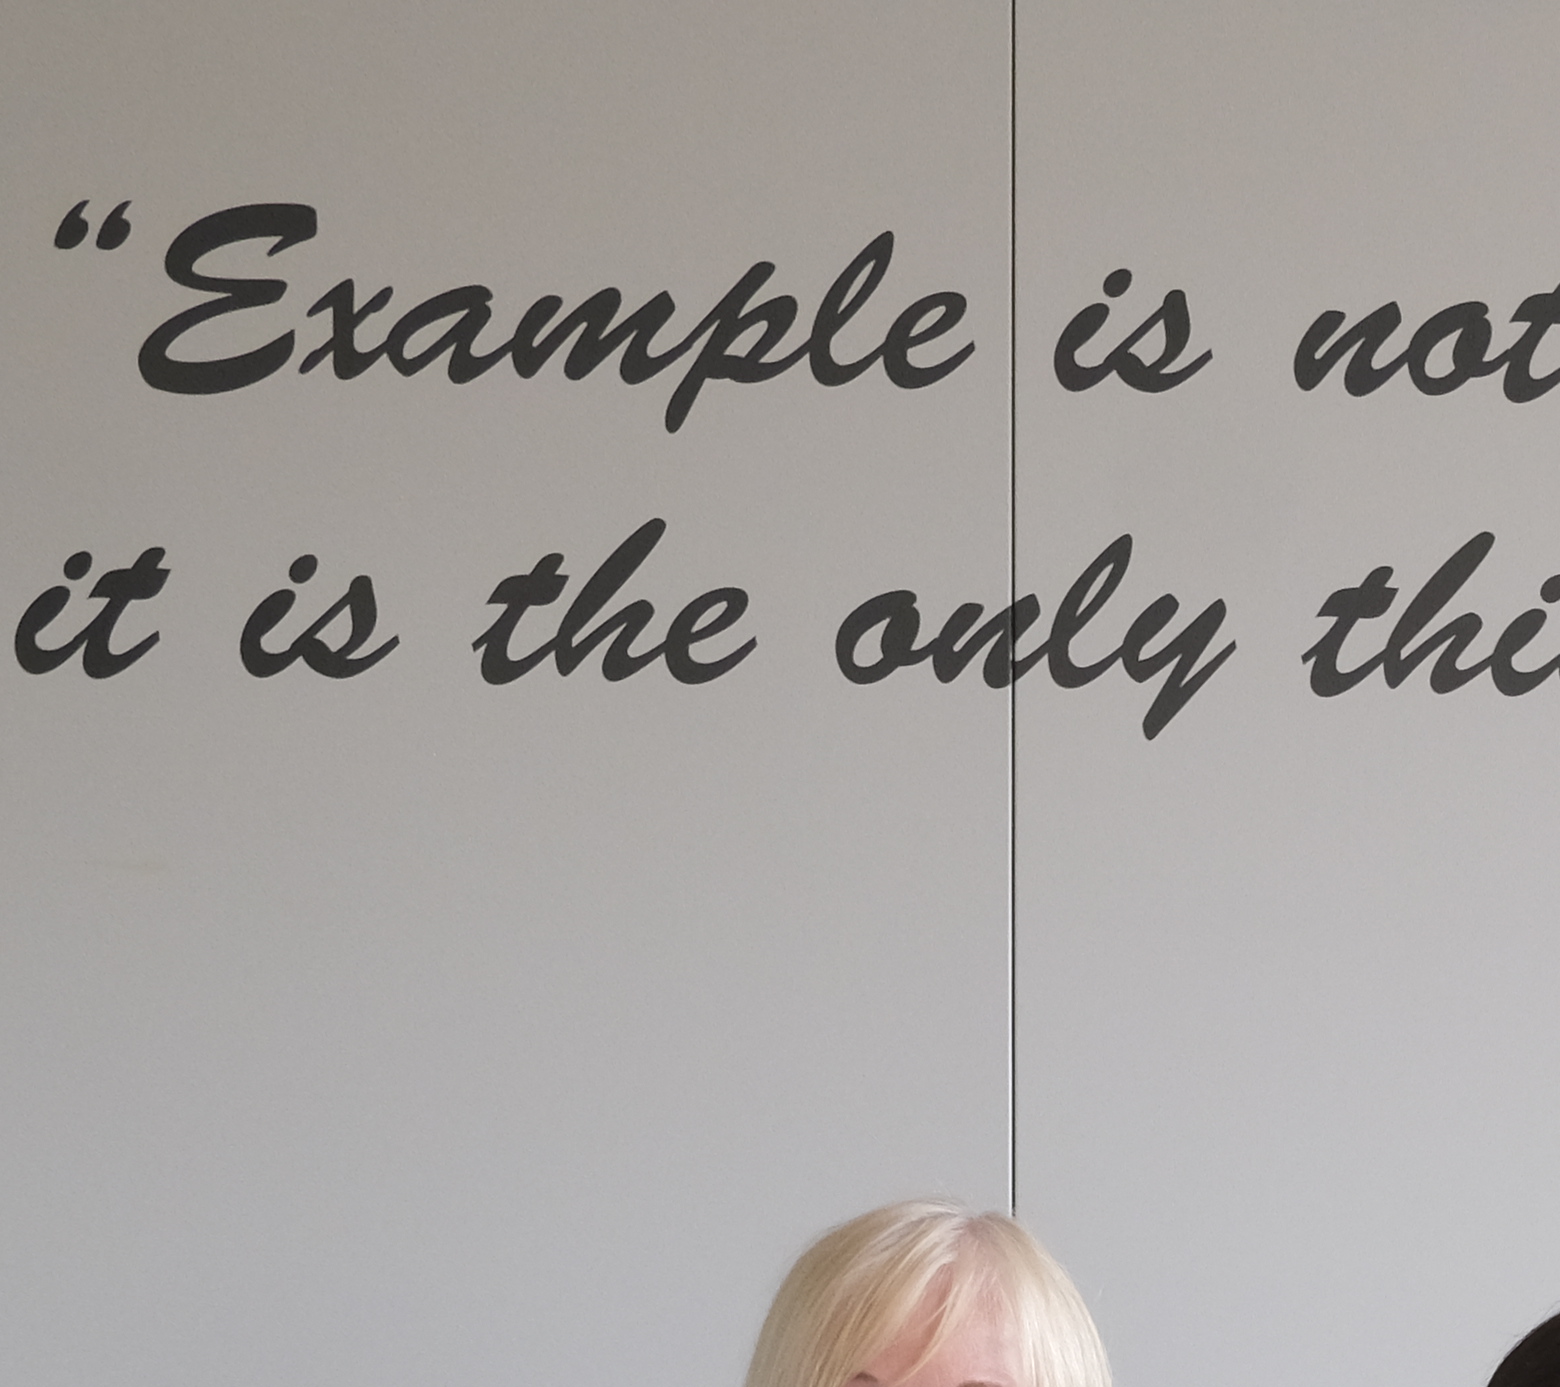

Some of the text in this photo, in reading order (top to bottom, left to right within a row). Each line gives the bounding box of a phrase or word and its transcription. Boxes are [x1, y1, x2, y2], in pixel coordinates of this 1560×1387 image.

[1070, 268, 1213, 394] is
[13, 546, 171, 680] it
[239, 554, 400, 680] is
[471, 517, 758, 686] the
[834, 532, 1237, 738] only
